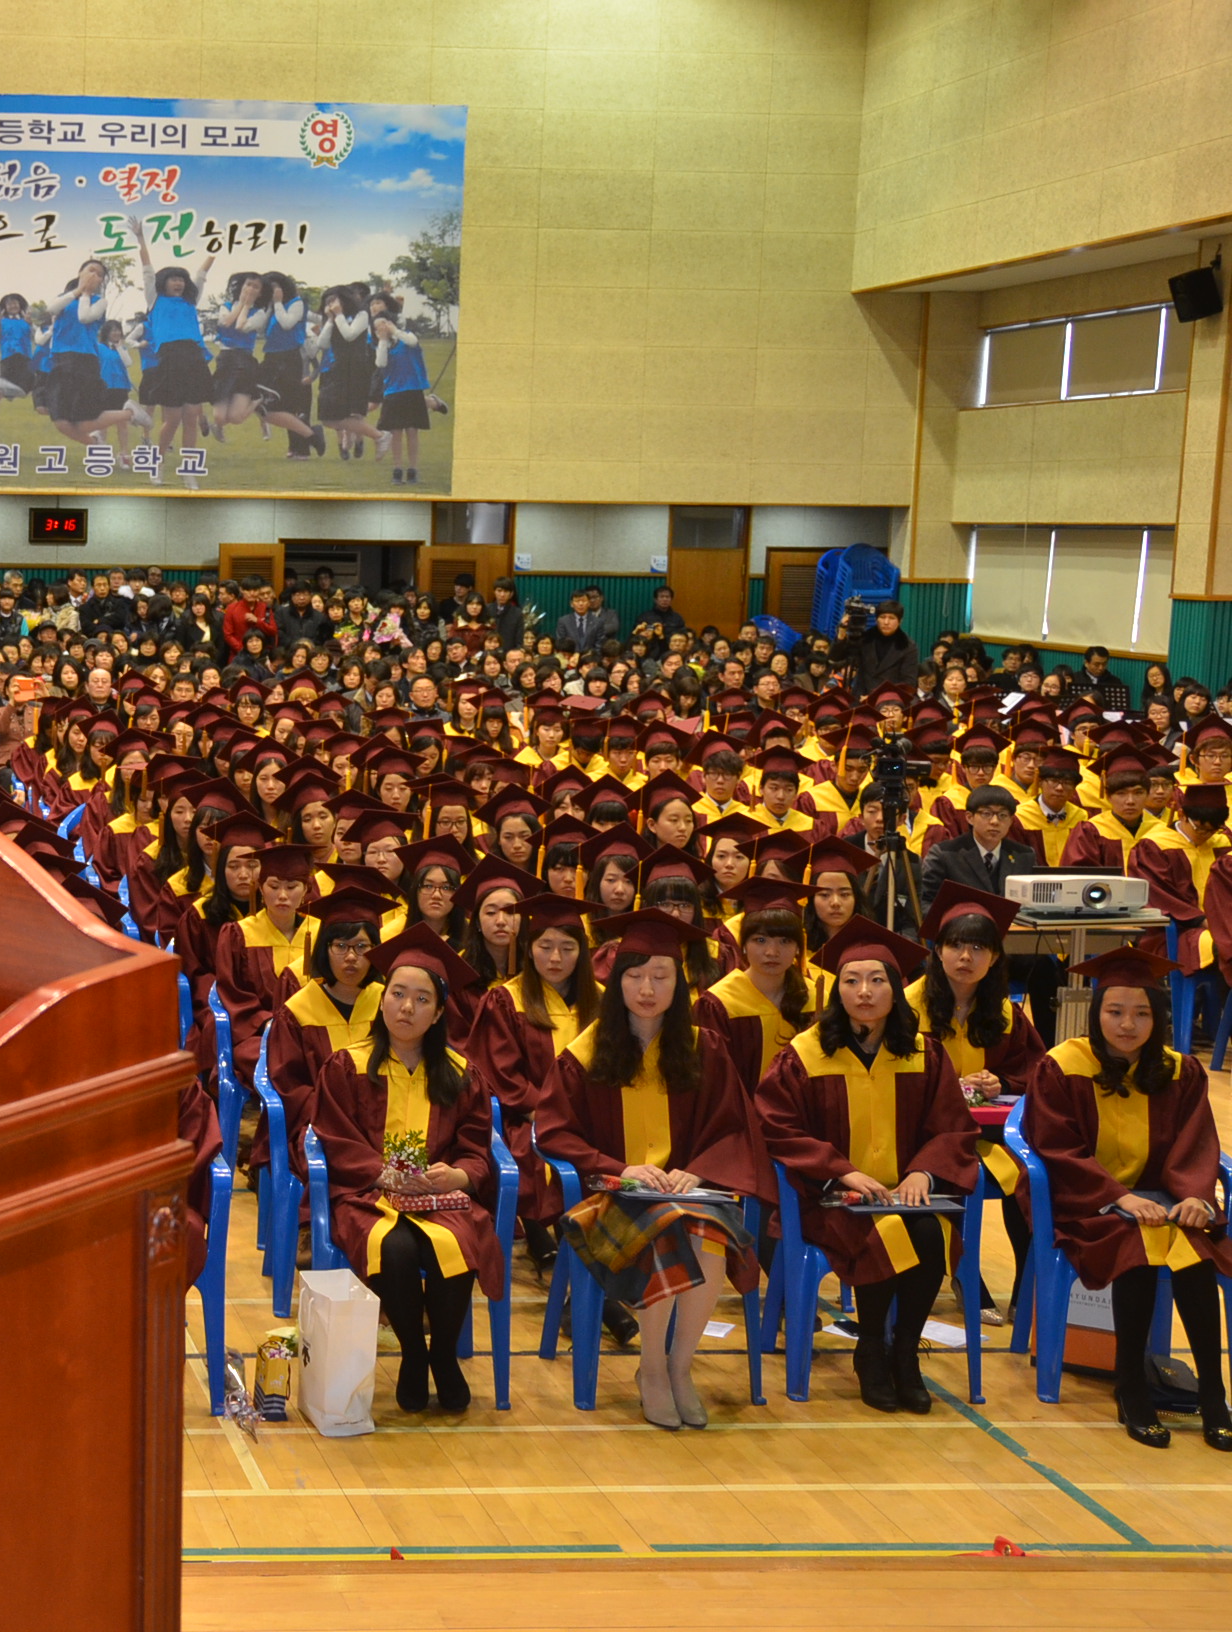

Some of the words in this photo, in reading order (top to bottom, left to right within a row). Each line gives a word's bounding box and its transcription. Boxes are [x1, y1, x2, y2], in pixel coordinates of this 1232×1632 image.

[98, 121, 188, 148] 우리의
[200, 126, 260, 148] 모교
[310, 119, 339, 154] 영
[102, 166, 178, 202] 열정
[94, 212, 307, 258] 도전하라!
